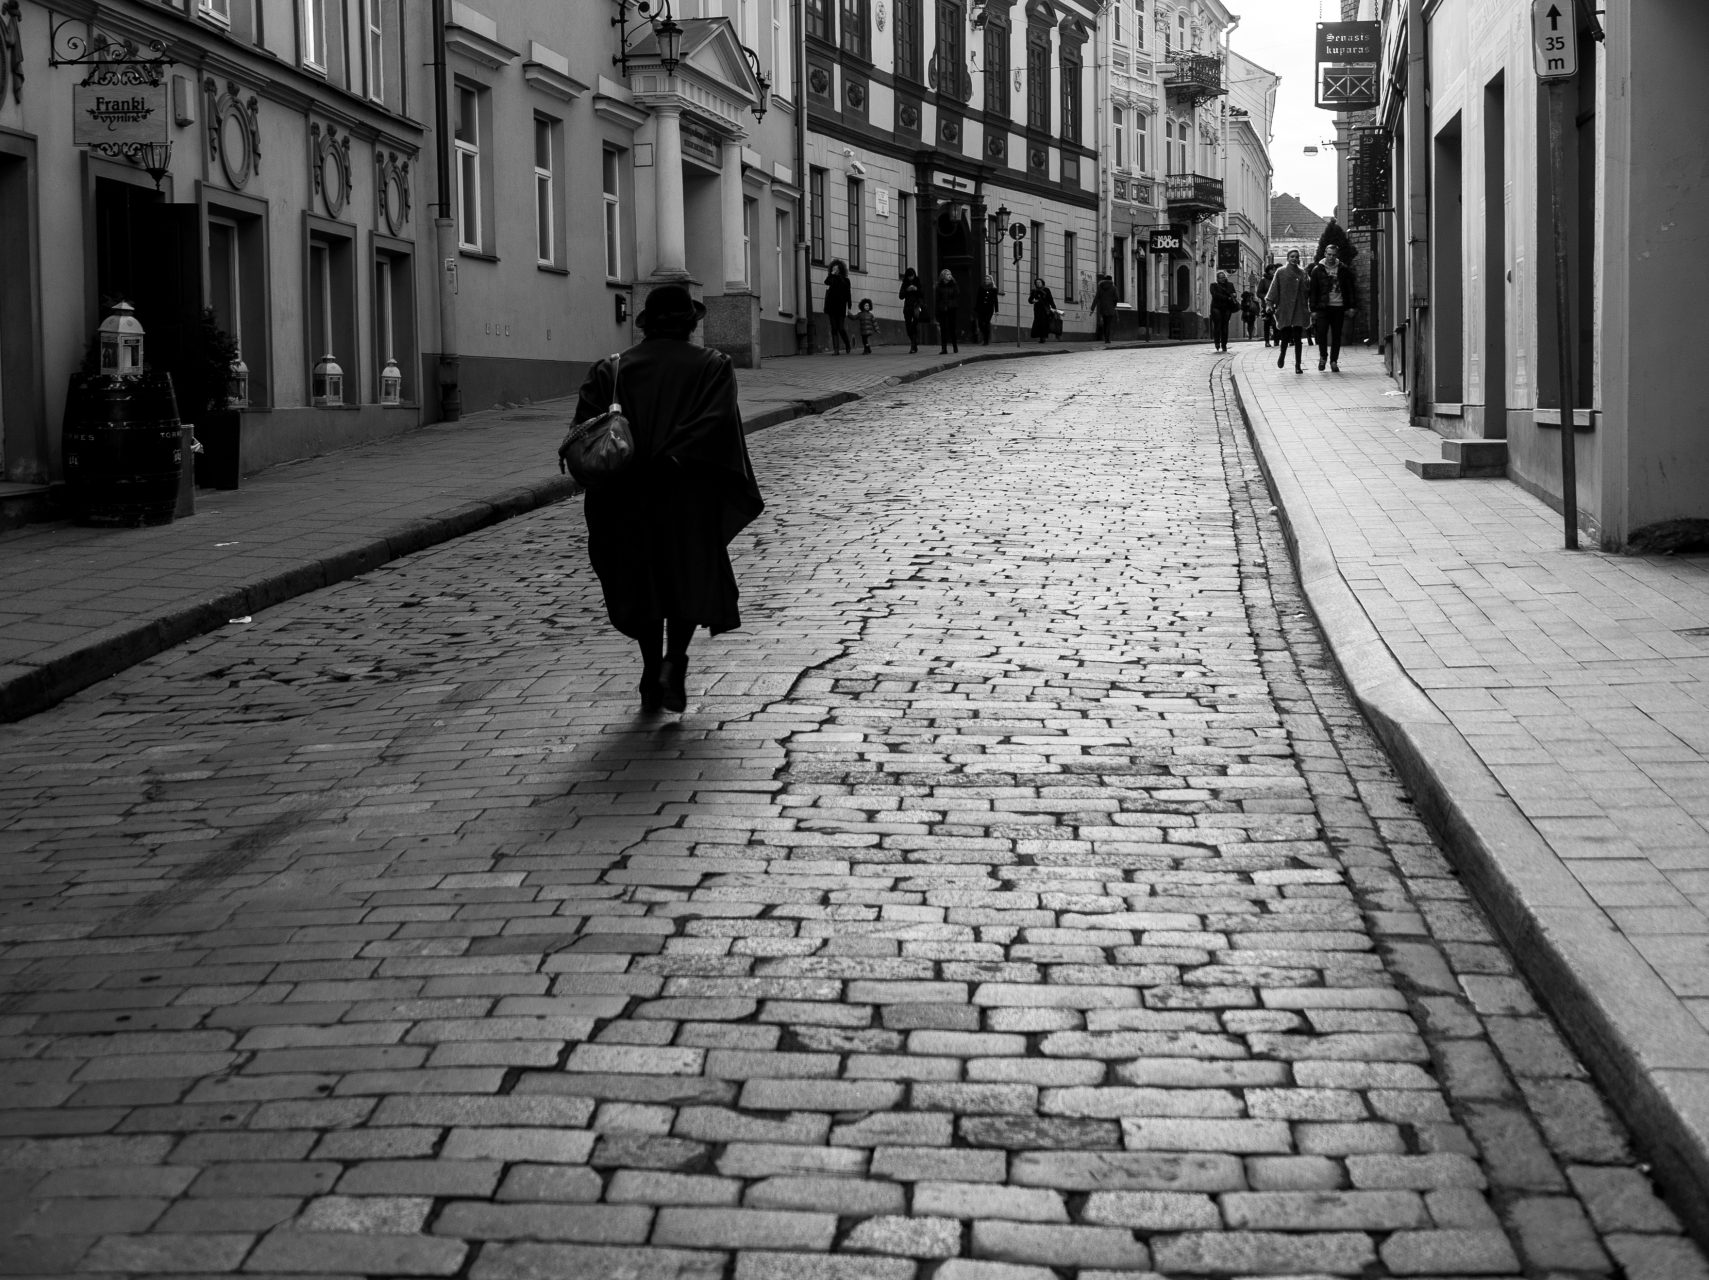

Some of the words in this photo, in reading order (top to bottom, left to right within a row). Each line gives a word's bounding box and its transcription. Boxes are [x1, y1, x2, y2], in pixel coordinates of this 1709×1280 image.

[1326, 33, 1370, 42] Senasis
[1544, 36, 1565, 51] 35
[1326, 45, 1370, 56] kuparas
[1548, 58, 1565, 70] m
[95, 96, 145, 111] Franki
[1157, 238, 1179, 248] DOG
